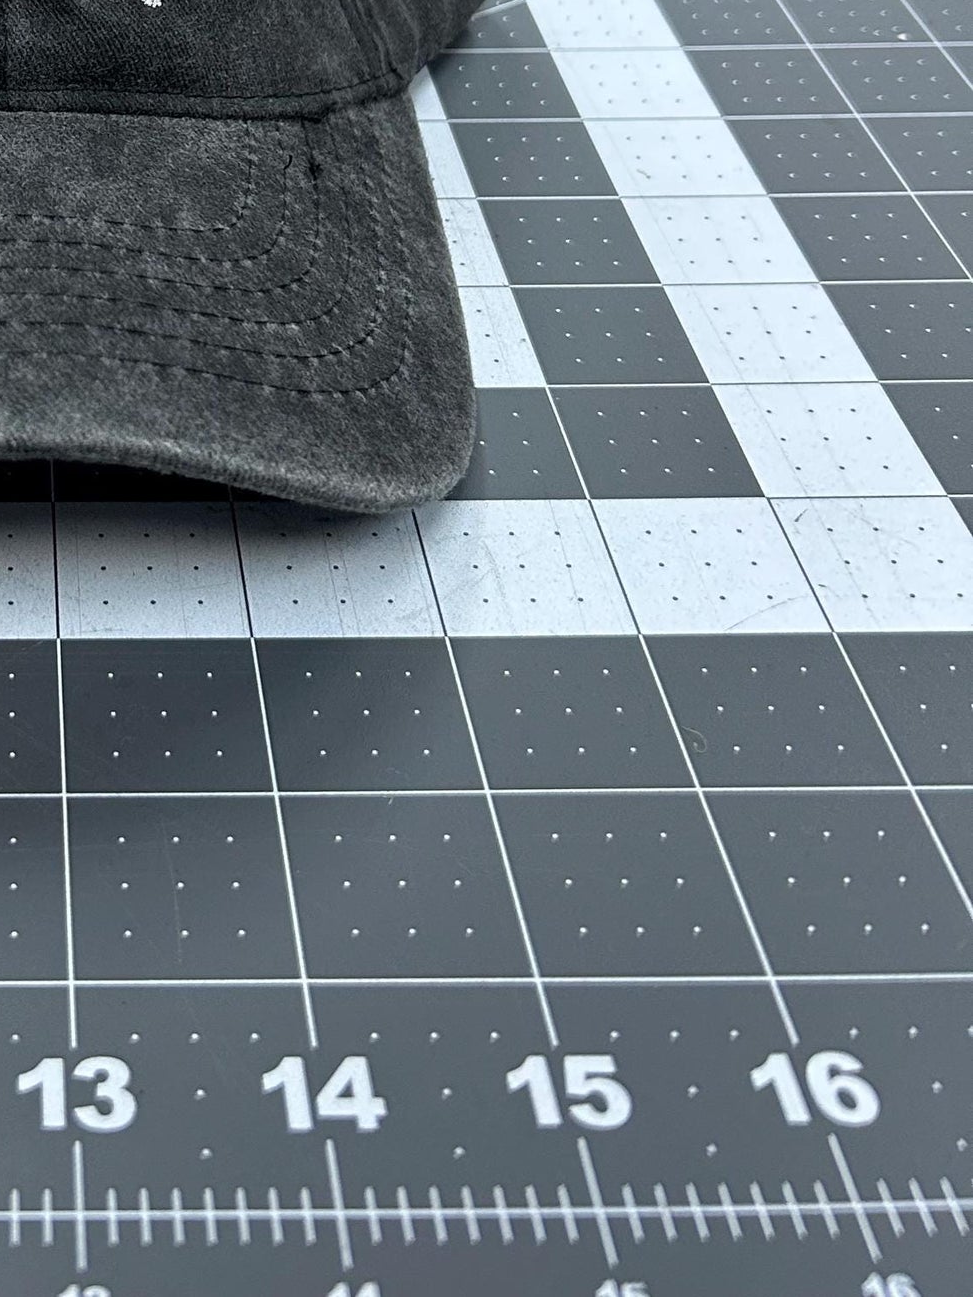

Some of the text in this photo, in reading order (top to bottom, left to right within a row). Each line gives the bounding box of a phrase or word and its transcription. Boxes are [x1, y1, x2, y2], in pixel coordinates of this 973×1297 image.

[17, 1056, 136, 1131] 13
[262, 1056, 387, 1131] 14
[506, 1055, 631, 1128] 15
[750, 1052, 879, 1126] 16
